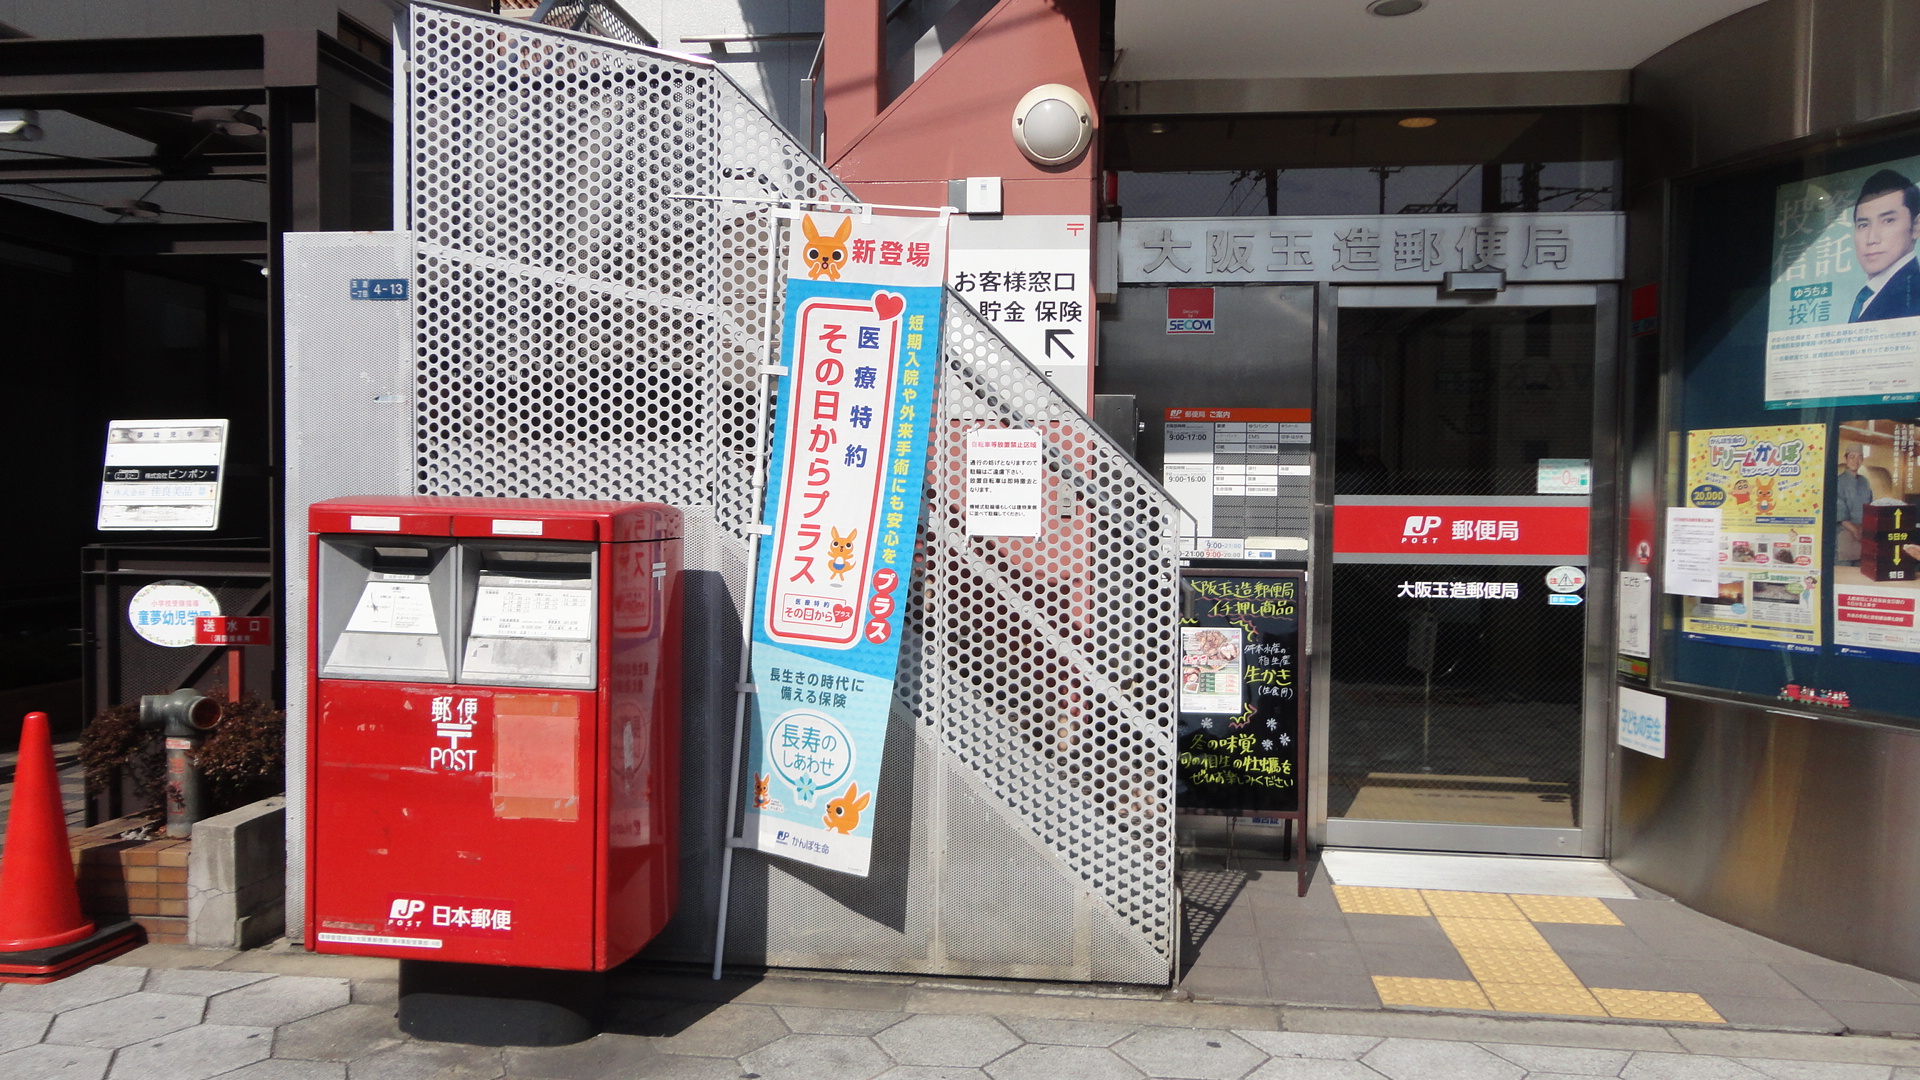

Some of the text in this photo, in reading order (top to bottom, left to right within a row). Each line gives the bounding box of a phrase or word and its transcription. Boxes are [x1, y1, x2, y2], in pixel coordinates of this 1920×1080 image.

[852, 238, 931, 268] 新登場
[1141, 226, 1572, 273] 大阪玉造郵便局
[373, 284, 403, 294] 4-13
[954, 271, 1075, 292] お客様窓口
[1793, 286, 1829, 298] ゆうちょ
[979, 301, 1082, 322] 貯金 保険
[1788, 300, 1831, 325] 投信
[1169, 320, 1211, 330] SECOM
[844, 326, 881, 468] 医療特約
[882, 315, 924, 564] 短期入院や外来手術にも安心を
[789, 324, 847, 585] その日からプラス
[1712, 442, 1801, 467] ドリームかんぽ
[1693, 491, 1724, 502] 20,000
[1403, 516, 1519, 541] JP 郵便局
[1397, 581, 1519, 600] 大阪玉造郵便局
[795, 598, 830, 608] 医療特約
[868, 573, 895, 641] プラス
[1208, 600, 1294, 616] イチ押し商品
[785, 607, 833, 623] その日から
[834, 610, 850, 618] プラス
[203, 619, 260, 632] 送水口
[1258, 655, 1291, 667] 相生産
[770, 667, 865, 693] 長生きの時代に
[1244, 665, 1292, 686] 生かき
[780, 686, 848, 708] 備える保険
[431, 696, 478, 724] 郵便
[782, 723, 837, 753] 長寿の
[1190, 733, 1256, 754] 冬の味覚
[430, 748, 478, 771] POST
[782, 750, 835, 777] しあわせ
[792, 836, 830, 855] かんぽ生命
[387, 919, 422, 927] POST
[389, 899, 512, 931] JP 日本郵便
